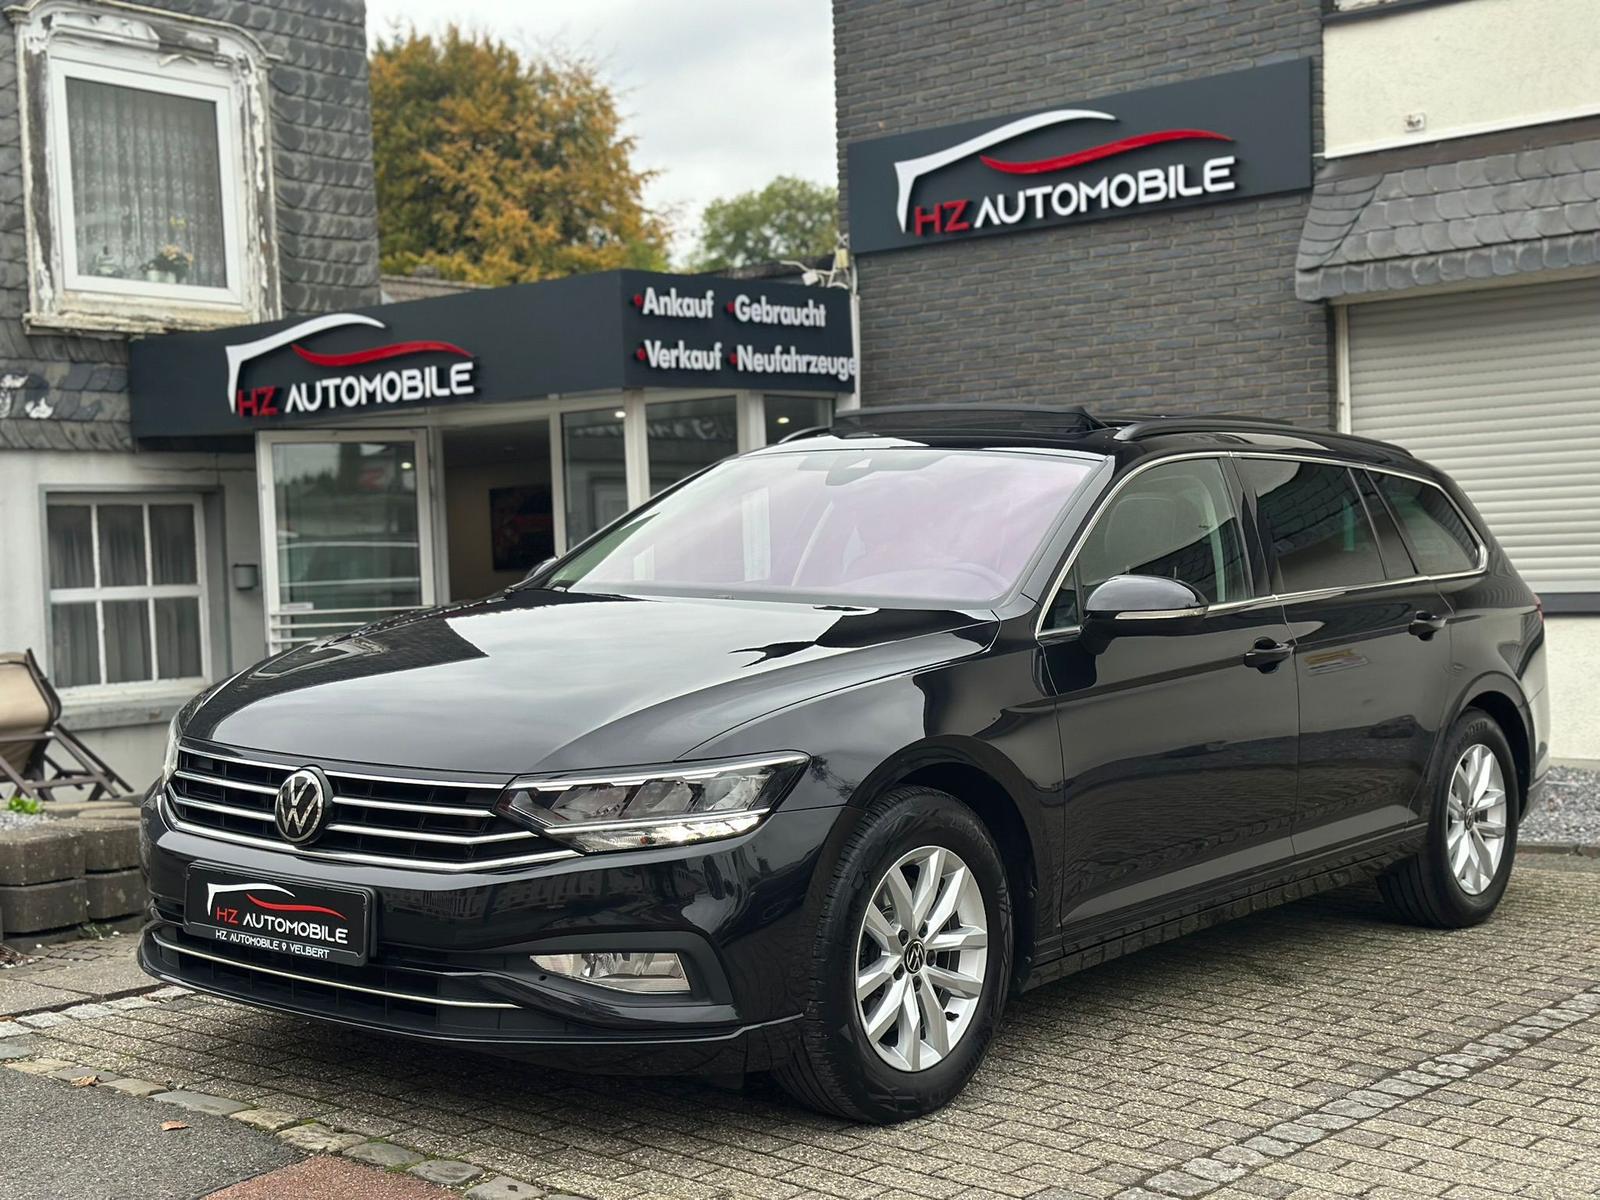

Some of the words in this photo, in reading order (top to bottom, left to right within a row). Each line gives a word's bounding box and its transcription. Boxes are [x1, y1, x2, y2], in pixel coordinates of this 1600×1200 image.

[914, 199, 970, 236] HZ
[974, 156, 1235, 228] AUTOMOBILE
[642, 287, 714, 318] Ankauf
[734, 294, 826, 327] Gebraucht
[644, 339, 722, 370] Verkauf
[237, 386, 277, 417] HZ
[285, 362, 474, 413] AUTOMOBILE
[215, 929, 228, 940] HZ
[230, 933, 279, 950] AUTOMOBILE
[289, 943, 330, 959] VELBERT
[216, 906, 239, 925] HZ
[243, 912, 348, 944] AUTOMOBILE
